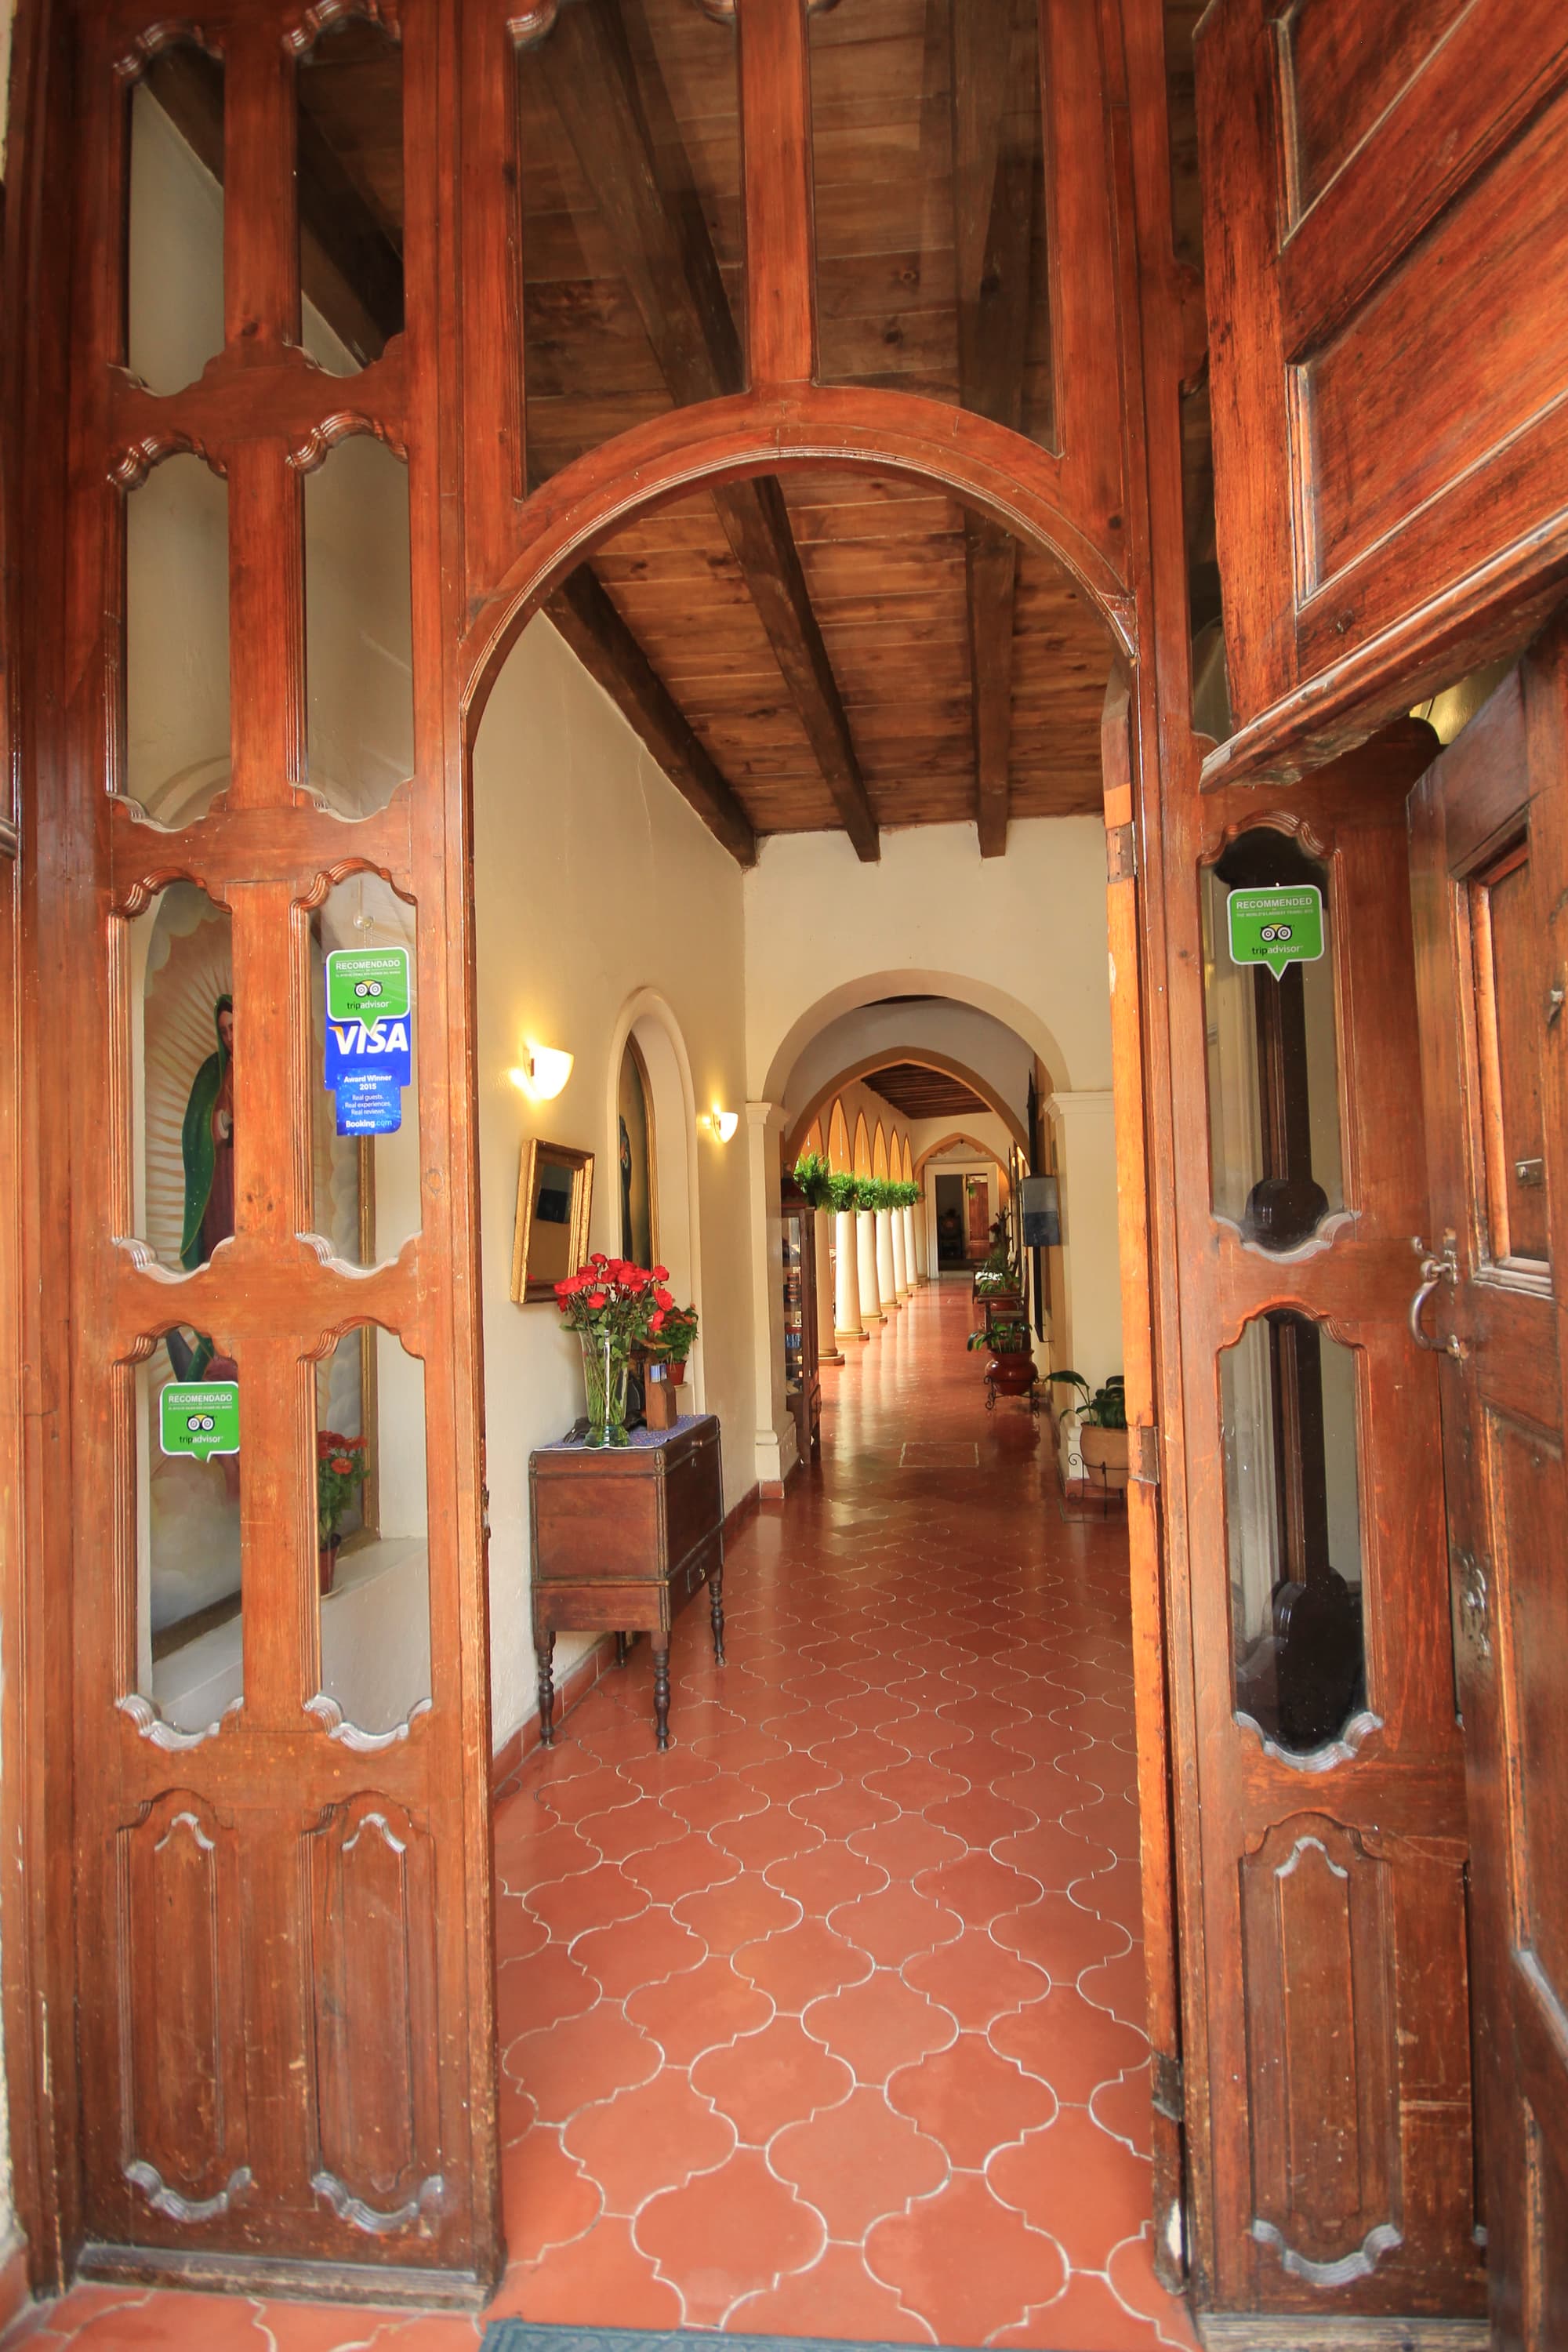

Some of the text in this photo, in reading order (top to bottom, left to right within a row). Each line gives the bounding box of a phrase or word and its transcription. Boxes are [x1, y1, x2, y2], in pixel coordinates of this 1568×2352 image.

[1236, 897, 1312, 909] RECOMMENDED
[1252, 945, 1301, 956] tripadvisor
[336, 960, 401, 970] RECOMENDADO
[347, 1000, 390, 1011] tripadvisor
[328, 1022, 408, 1054] VISA
[344, 1074, 392, 1083] Award Winner
[346, 1119, 392, 1129] Booking.com
[169, 1394, 233, 1403] RECOMENDADO
[179, 1435, 221, 1445] tripadvisor
